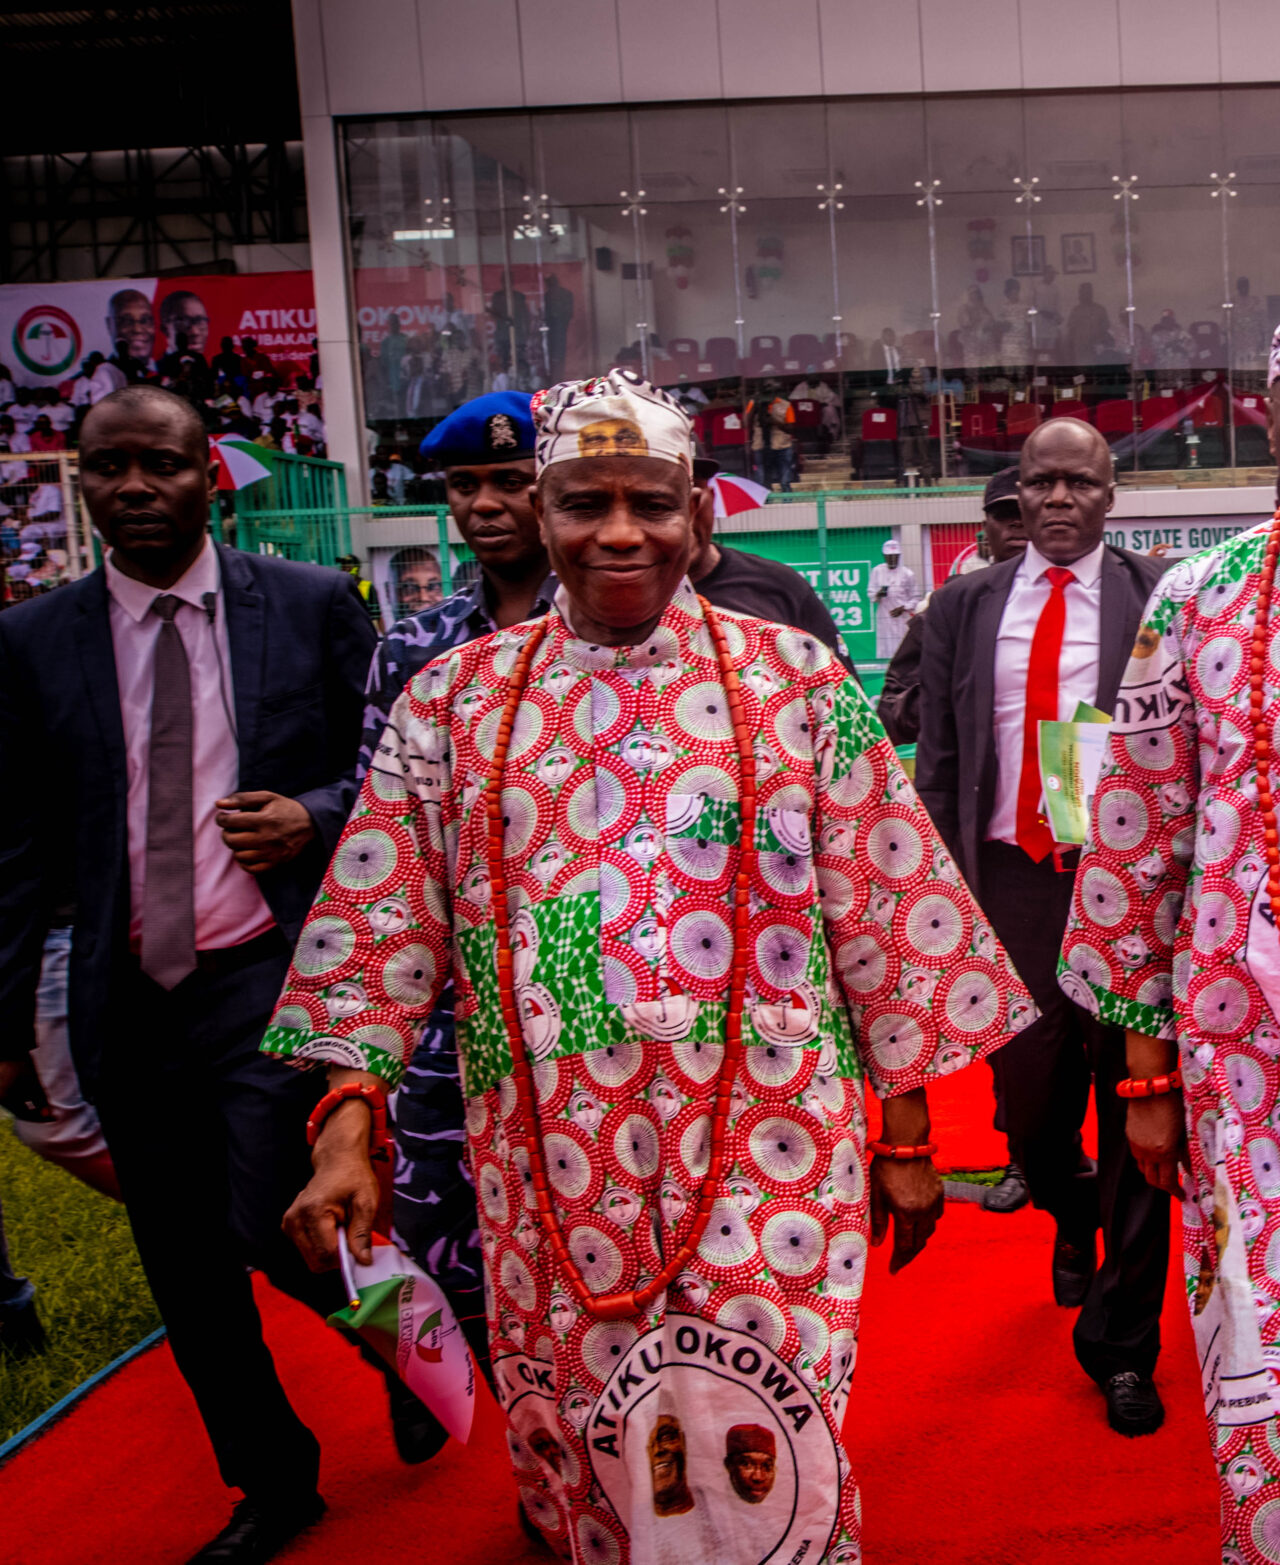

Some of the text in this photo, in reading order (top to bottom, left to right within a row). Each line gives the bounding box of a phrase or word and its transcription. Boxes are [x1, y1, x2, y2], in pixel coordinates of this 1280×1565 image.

[238, 308, 316, 330] ATIKU
[1132, 529, 1182, 550] STATE
[592, 1326, 813, 1458] ATIKU OKOWA
